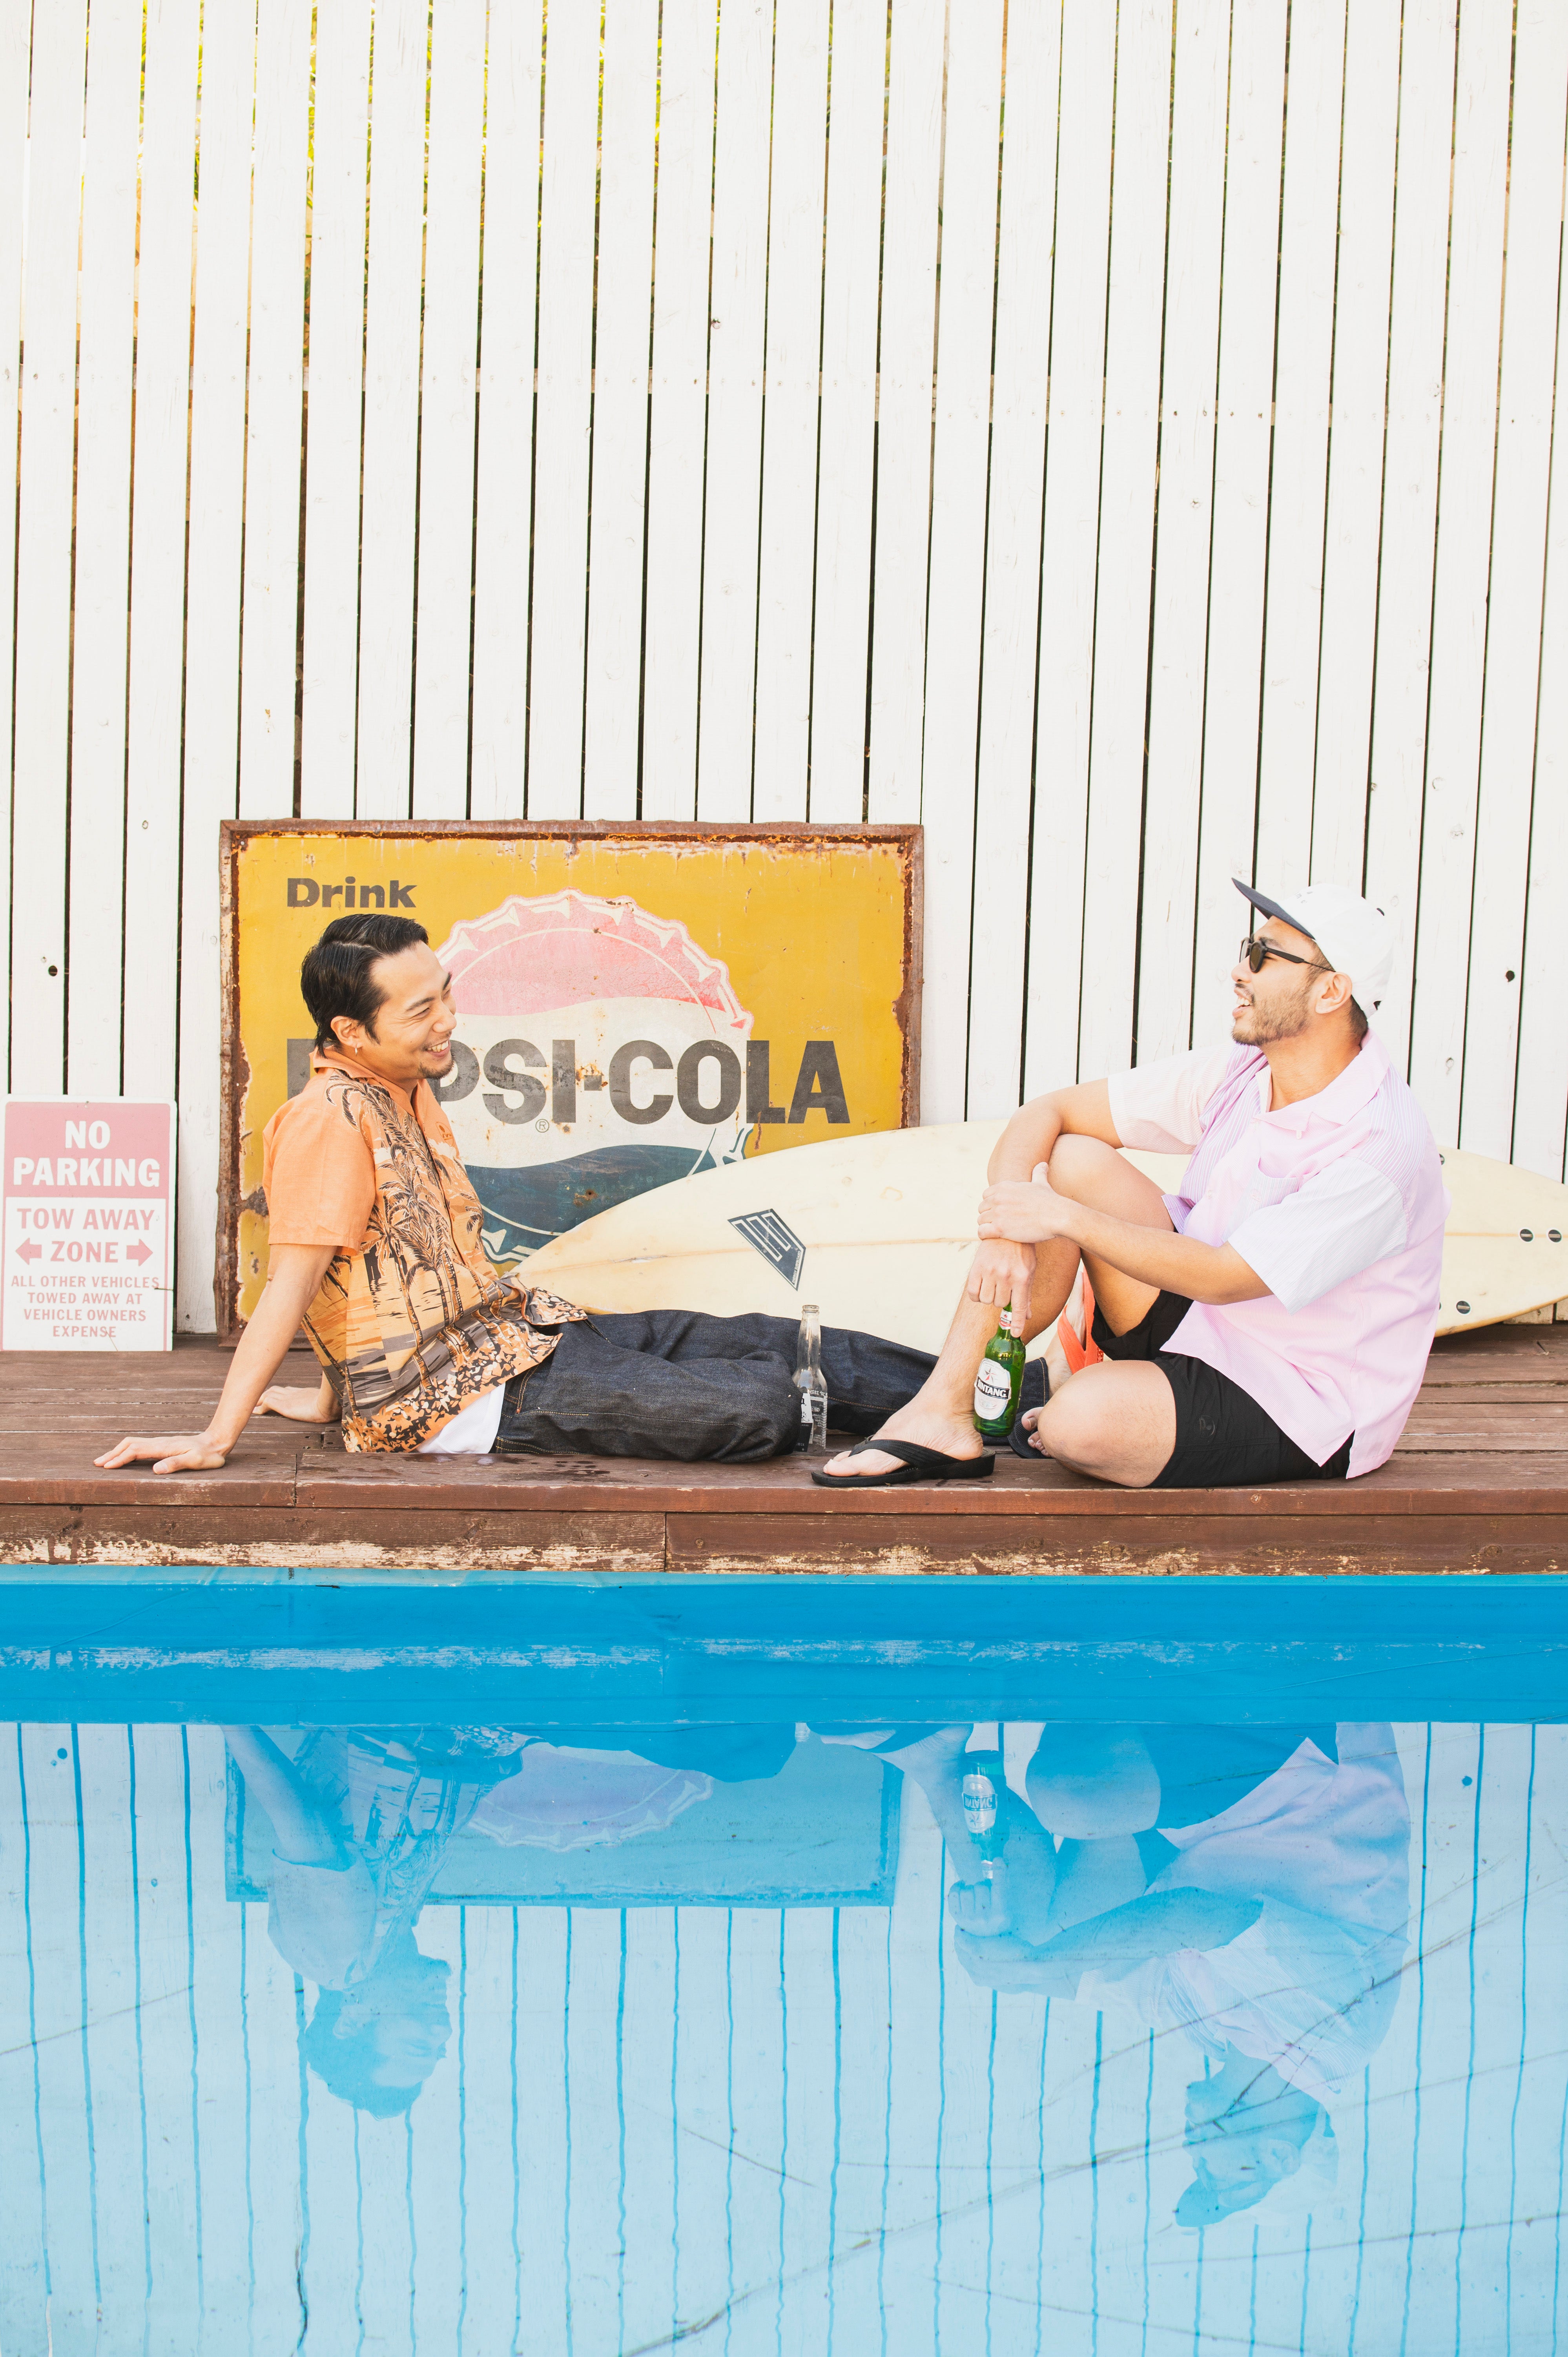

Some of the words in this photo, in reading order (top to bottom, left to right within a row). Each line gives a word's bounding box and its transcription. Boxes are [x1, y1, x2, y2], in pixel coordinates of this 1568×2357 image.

[287, 876, 416, 908] Drink
[287, 1038, 851, 1125] PSI-COLA
[65, 1120, 111, 1149] NO
[13, 1157, 160, 1188] PARKING
[17, 1208, 74, 1230] TOW
[83, 1209, 155, 1230] AWAY
[50, 1241, 119, 1263] ZONE
[11, 1276, 35, 1287] ALL
[41, 1276, 86, 1288] OTHER
[92, 1277, 159, 1289] VEHICLES
[27, 1292, 76, 1304] TOWED
[82, 1293, 120, 1304] AWAY
[126, 1293, 142, 1304] AT
[24, 1309, 82, 1321] VEHICLE
[87, 1310, 146, 1321] OWNERS
[53, 1326, 116, 1337] EXPENSE
